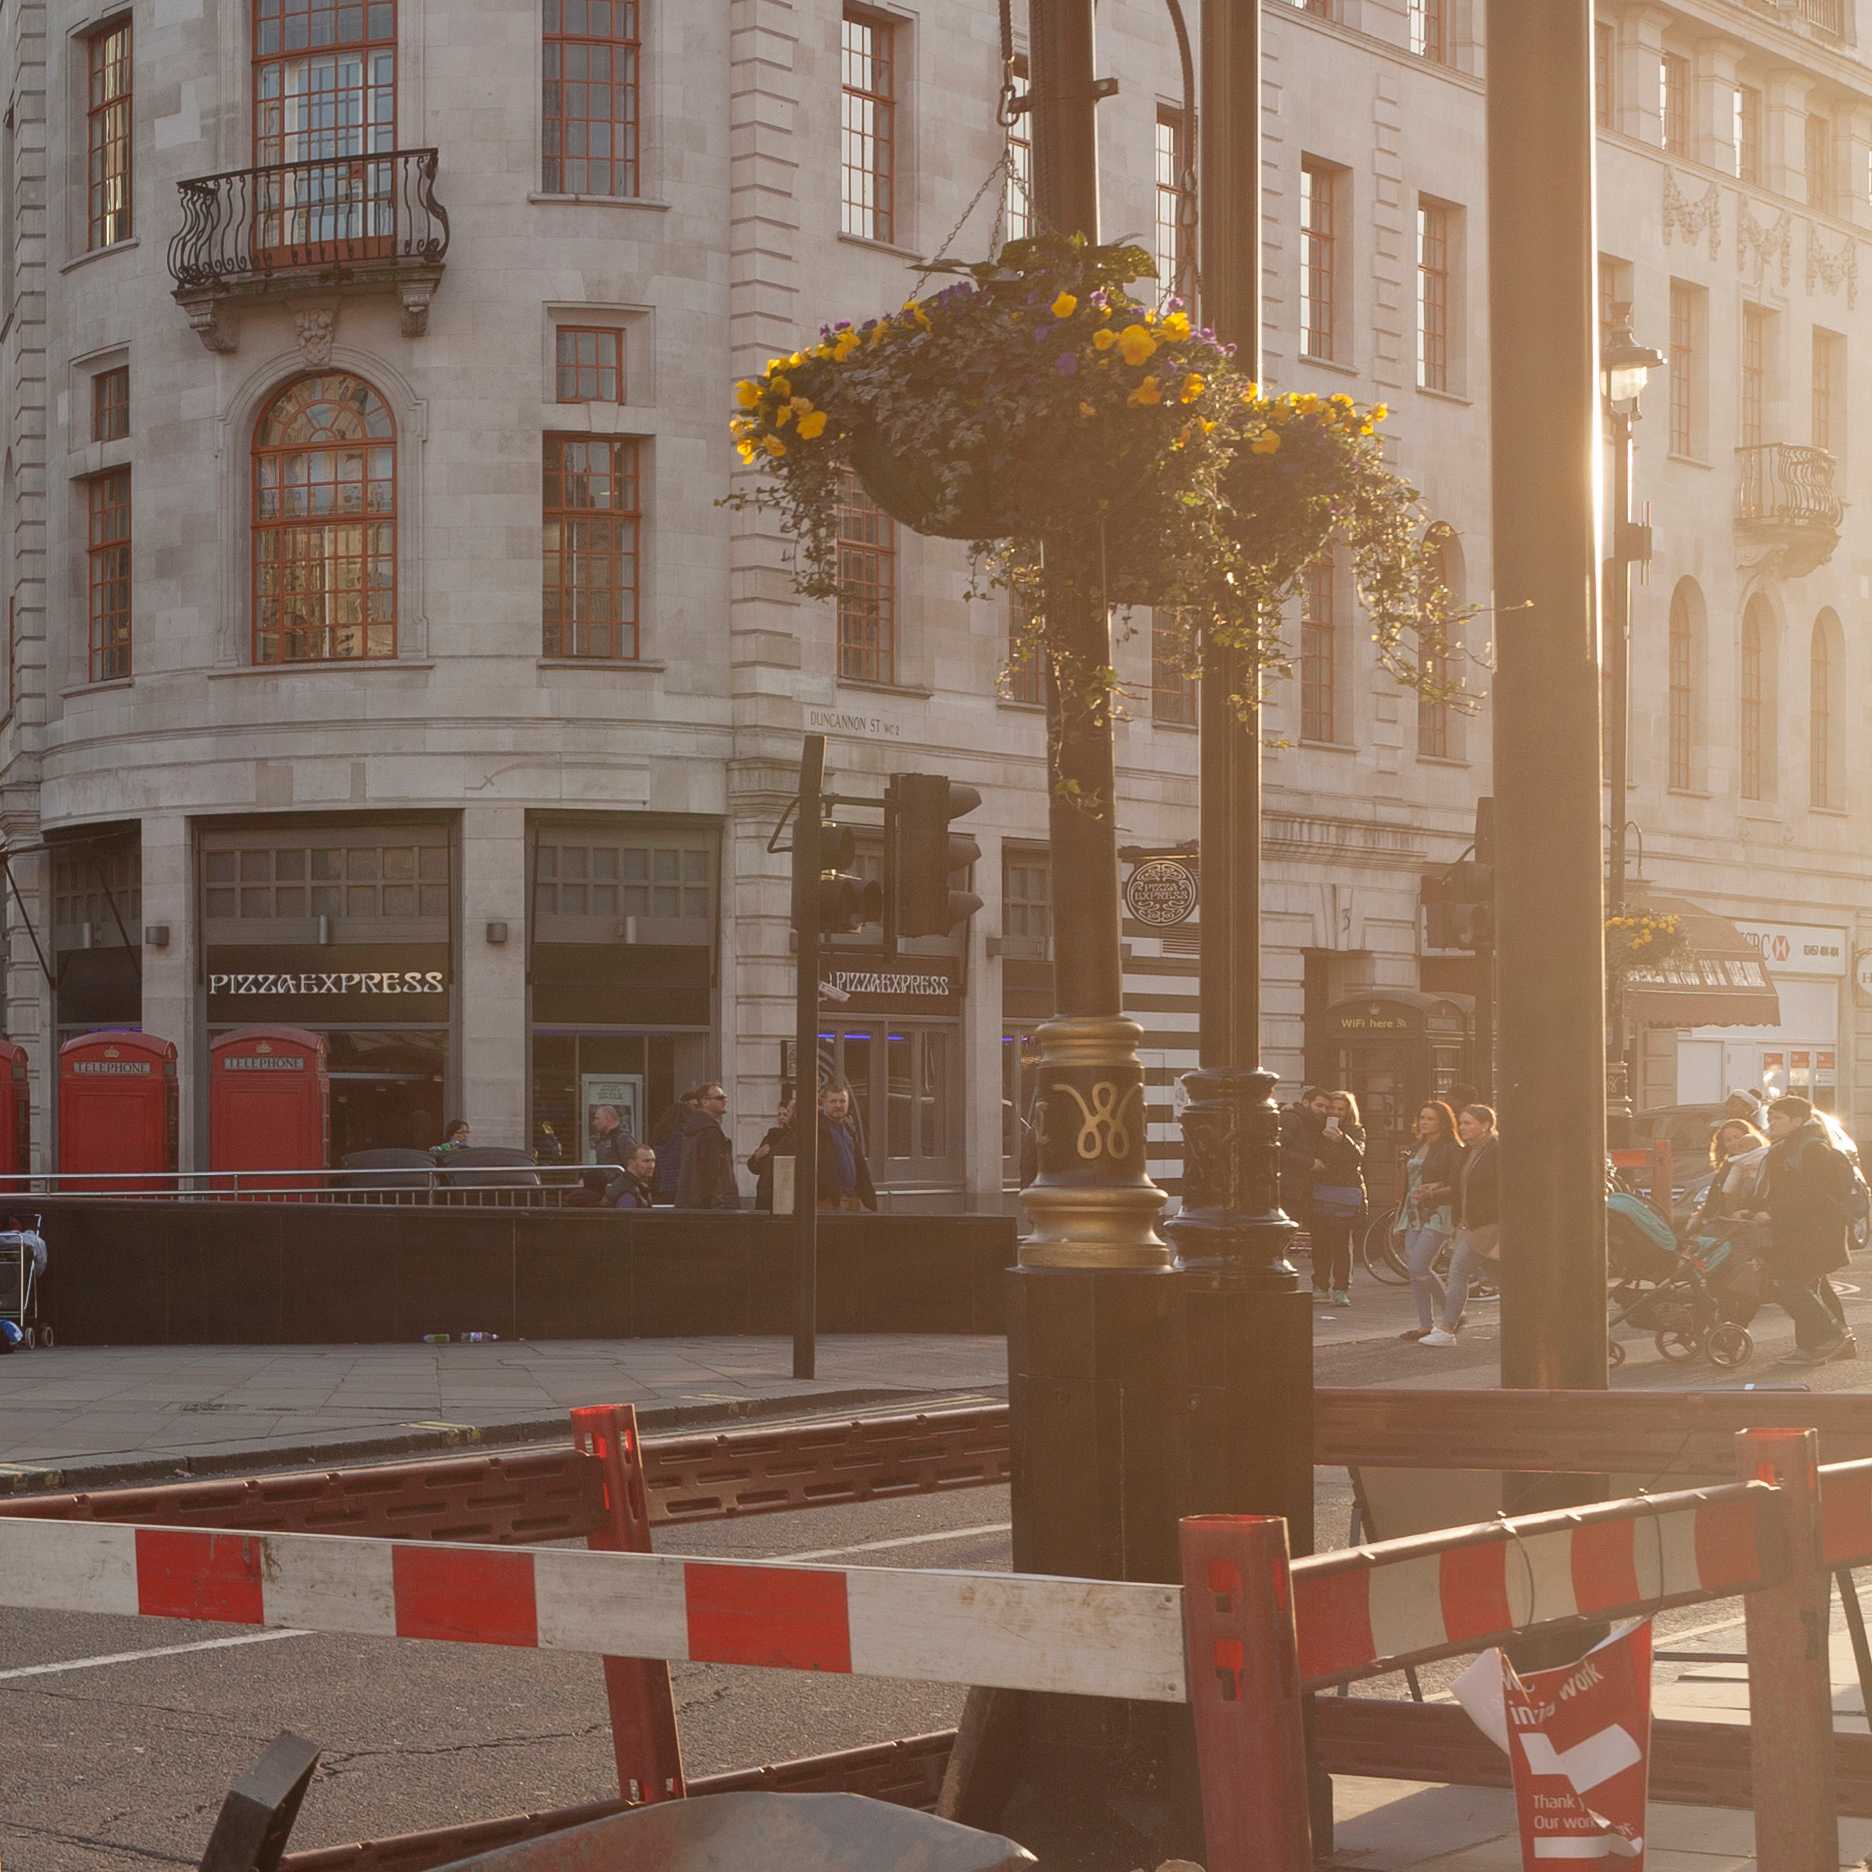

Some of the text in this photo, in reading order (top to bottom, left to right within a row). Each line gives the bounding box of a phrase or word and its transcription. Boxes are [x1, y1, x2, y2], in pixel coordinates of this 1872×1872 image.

[810, 711, 866, 730] DUNCANNON
[870, 719, 880, 733] ST
[209, 972, 444, 994] PIZZAEXPRESS
[836, 971, 949, 995] PIZZAEXPRESS
[1370, 1018, 1393, 1028] here
[77, 1062, 146, 1073] TELEPHONE
[228, 1057, 299, 1069] TELEPHONE
[1559, 1661, 1605, 1701] work
[1533, 1793, 1576, 1809] Thank
[1534, 1815, 1559, 1829] Our
